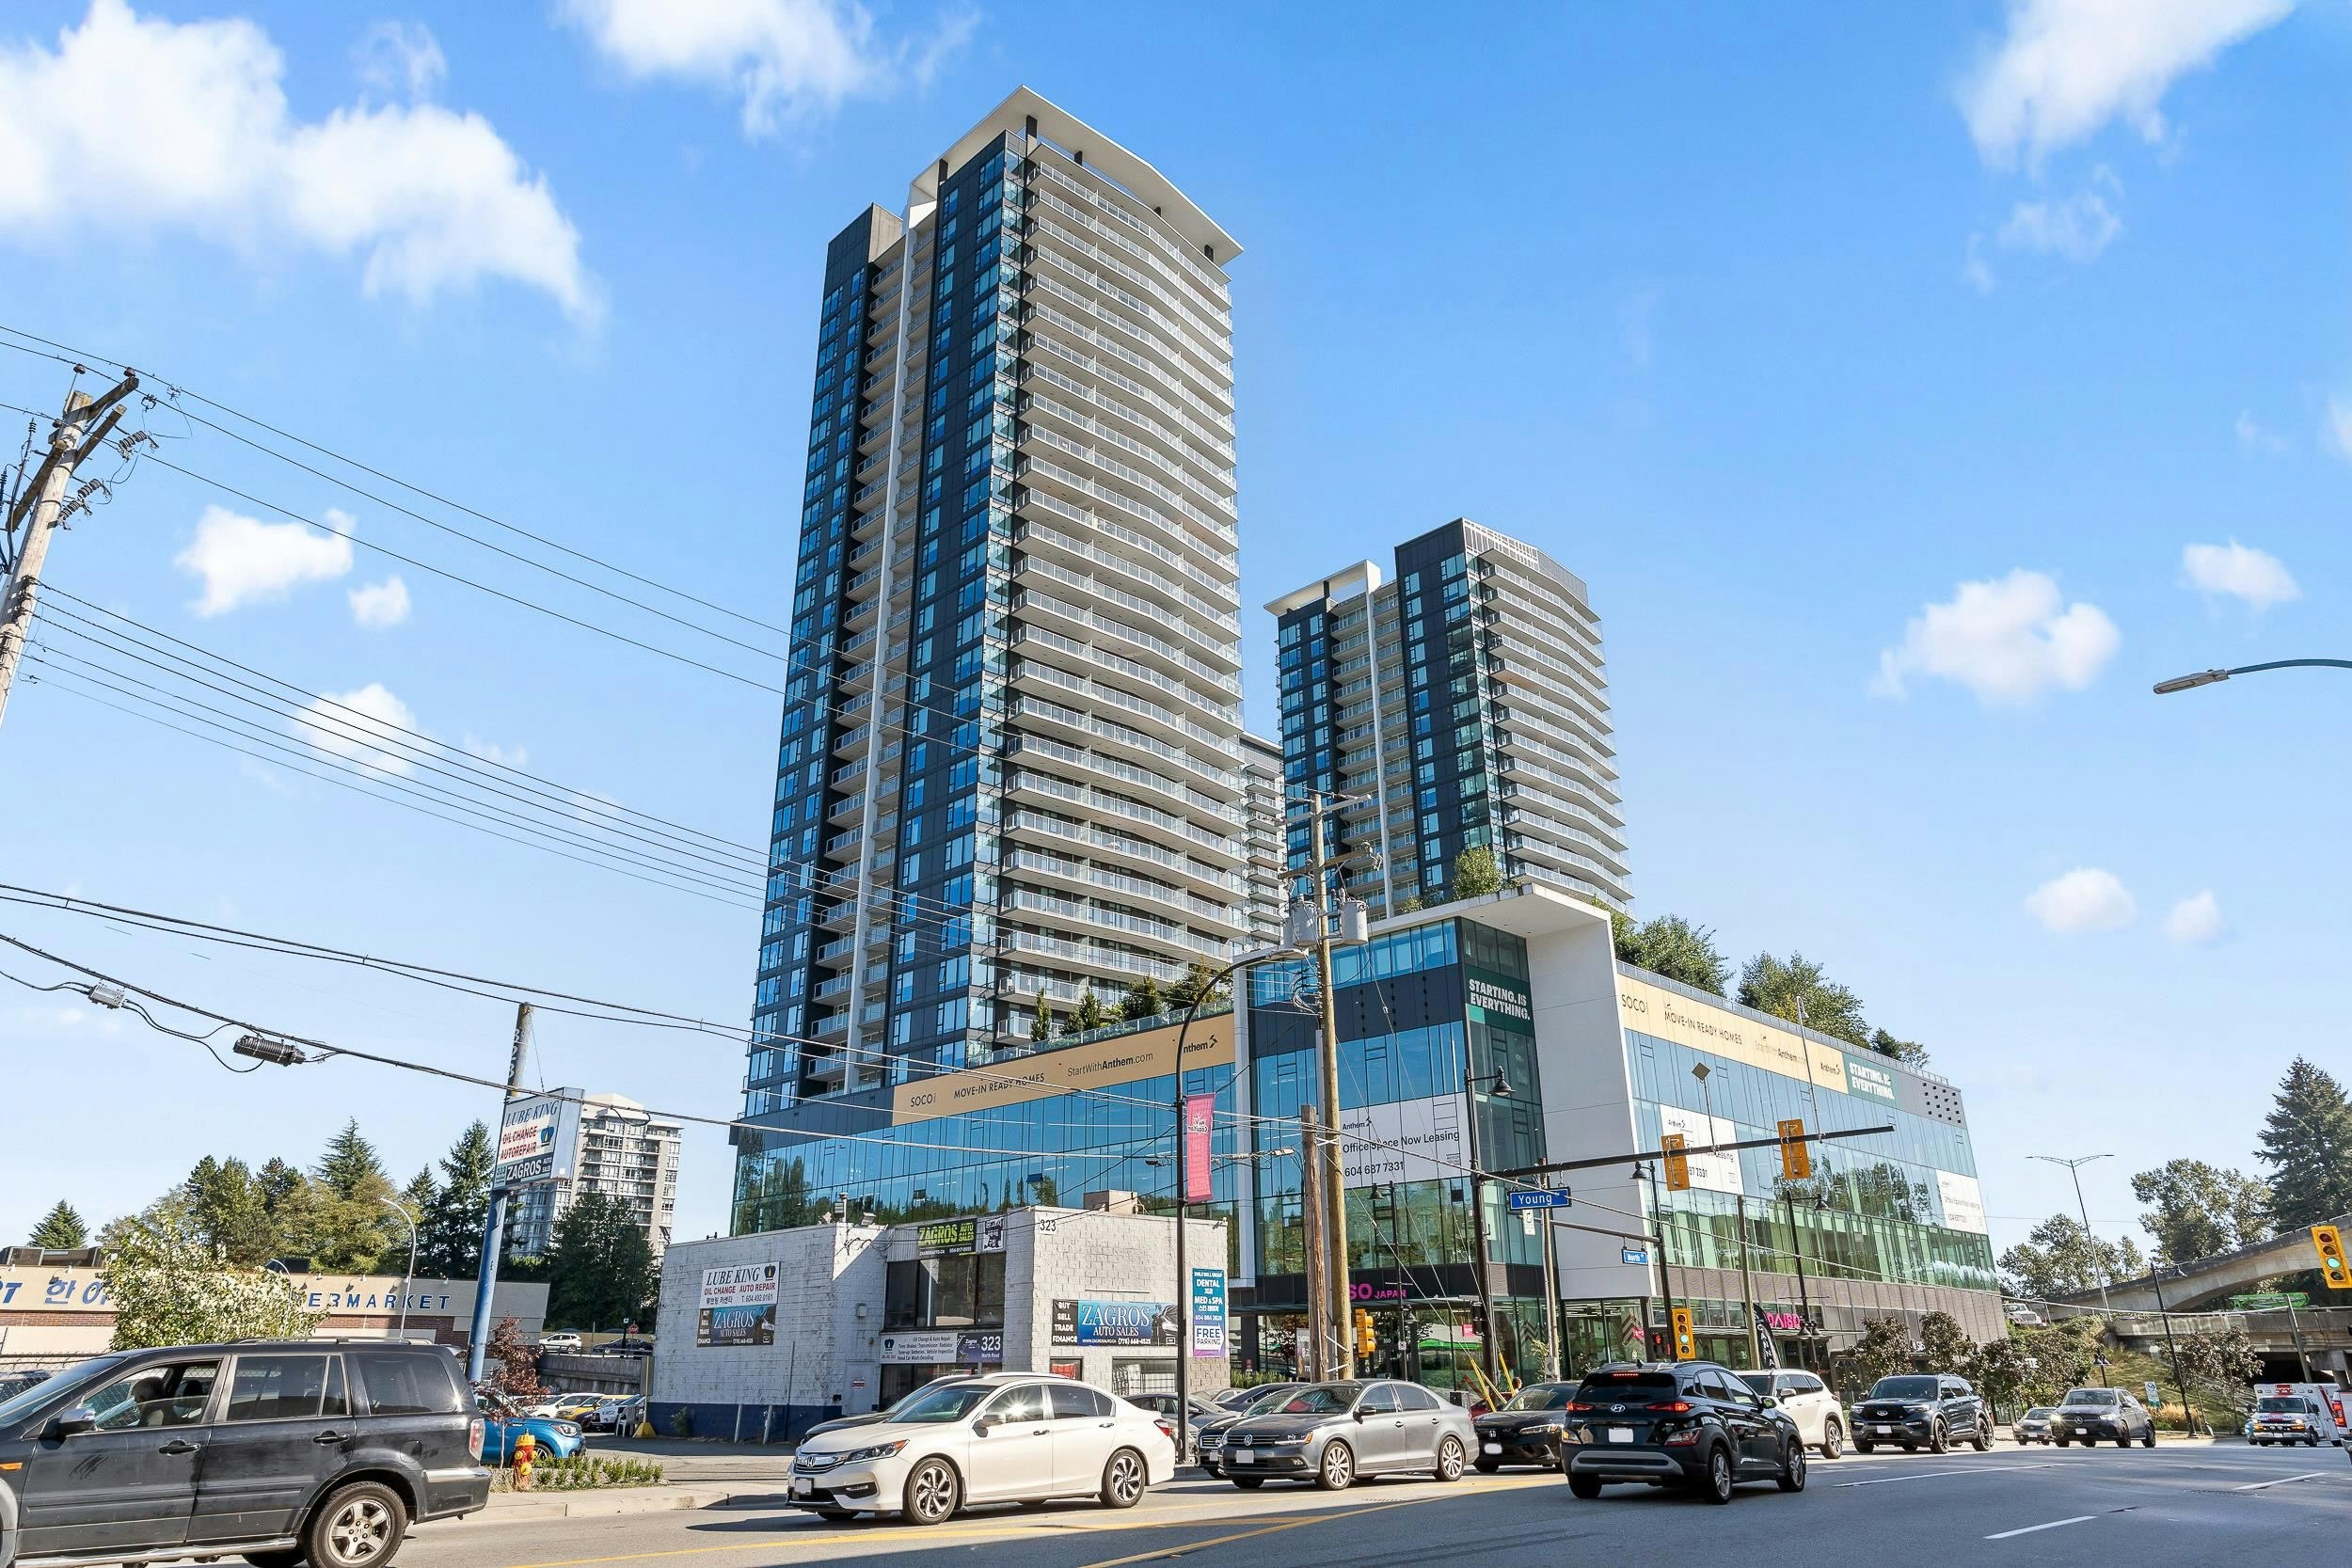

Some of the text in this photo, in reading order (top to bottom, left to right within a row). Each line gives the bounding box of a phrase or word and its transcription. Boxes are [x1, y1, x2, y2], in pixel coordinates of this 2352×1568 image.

[1469, 978, 1527, 1006] STARTING. IS
[1470, 991, 1531, 1021] EVERYTHING.
[1621, 993, 1645, 1014] SOCO
[1664, 1009, 1742, 1045] MOVE-IN READY HOMES
[1067, 1053, 1153, 1077] StartWithAnthem.com
[953, 1084, 987, 1100] MOVE-IN
[989, 1080, 1013, 1092] READY
[1015, 1072, 1045, 1086] HOMES
[910, 1093, 933, 1107] SOCO
[505, 1100, 560, 1128] LUBE KING
[1343, 1120, 1365, 1131] Anthem
[502, 1126, 538, 1145] OIL CHANGE
[1343, 1131, 1460, 1154] Office Space Now Leasing
[500, 1141, 537, 1161] AUTOREPAIR
[506, 1159, 542, 1181] ZAGROS
[1344, 1161, 1405, 1177] 604 687 7331
[1518, 1194, 1552, 1205] Young
[917, 1222, 974, 1246] ZAGROS AUTO
[1040, 1219, 1057, 1232] 323
[958, 1231, 975, 1242] SALES
[706, 1267, 761, 1286] LUBE KING
[1196, 1279, 1220, 1288] DENTAL
[704, 1282, 776, 1296] OIL CHANGE AUTO REPAIR
[1375, 1289, 1407, 1299] JAPAN
[308, 1292, 451, 1310] ERMARKET
[1057, 1301, 1071, 1309] BUY
[1194, 1295, 1208, 1304] MED
[1212, 1296, 1223, 1306] SPA
[713, 1310, 755, 1329] ZAGROS
[1081, 1305, 1150, 1327] ZAGROS
[732, 1328, 747, 1337] SALES
[1093, 1326, 1139, 1337] AUTO SALES
[1196, 1327, 1221, 1338] FREE
[980, 1335, 1001, 1352] 323
